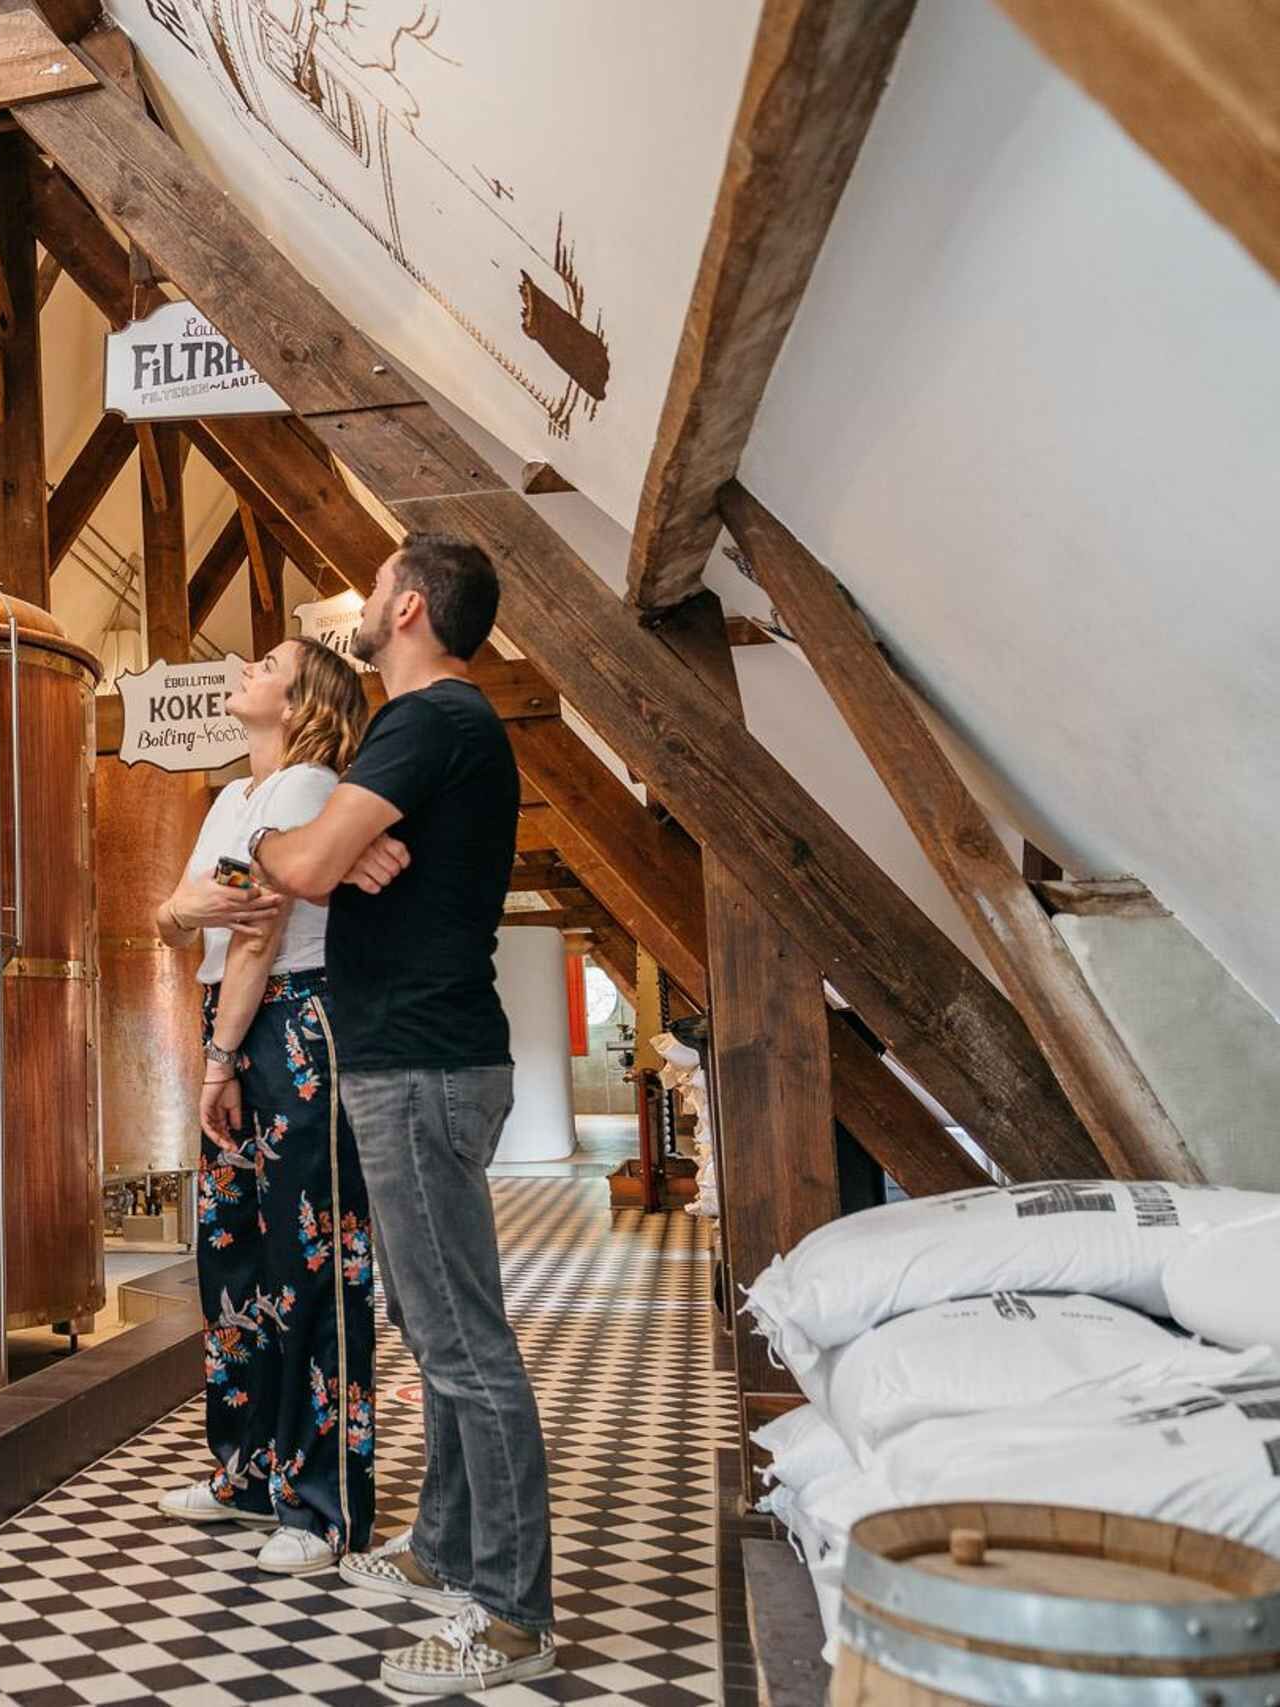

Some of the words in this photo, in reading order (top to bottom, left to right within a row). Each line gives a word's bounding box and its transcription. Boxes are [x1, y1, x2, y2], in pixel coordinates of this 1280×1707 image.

[132, 342, 247, 390] FiLTRA
[150, 691, 232, 722] KOKE
[137, 728, 196, 752] Boiling
